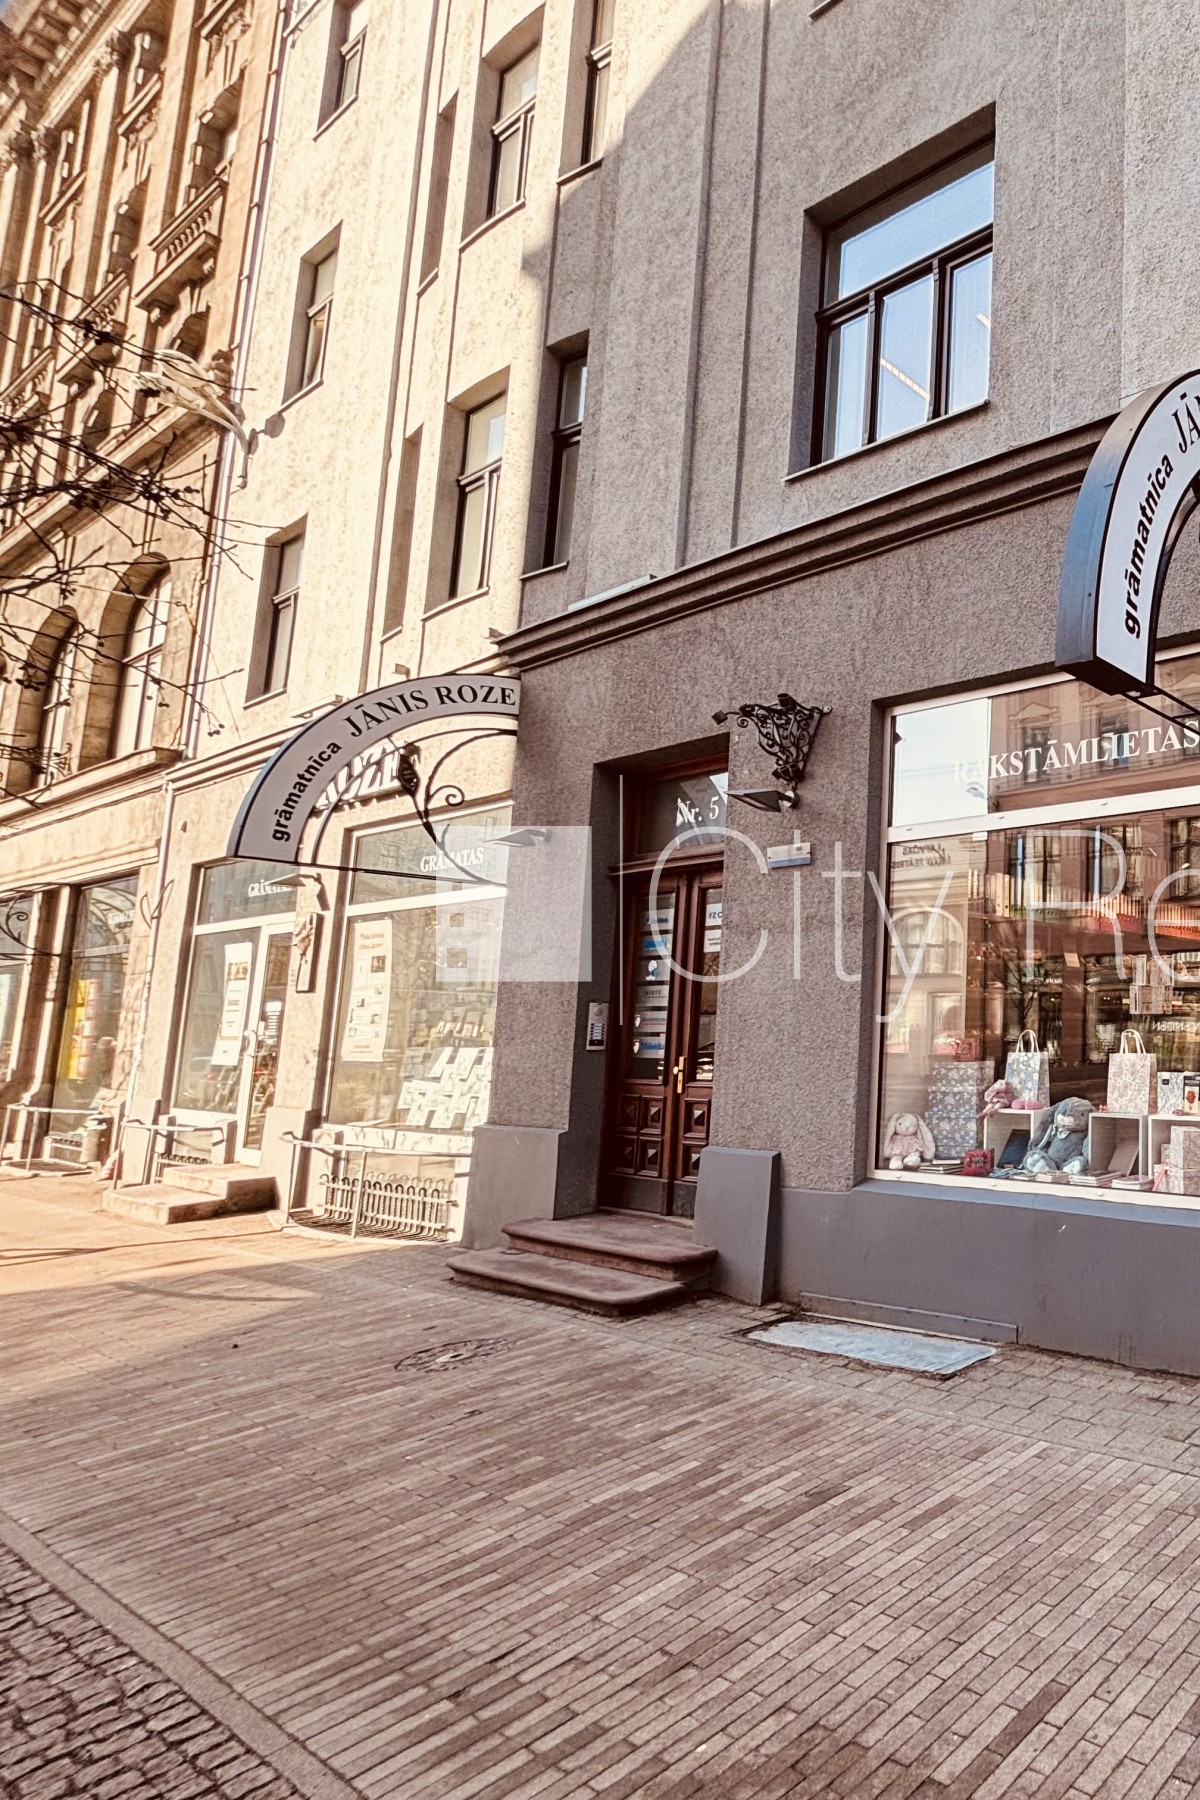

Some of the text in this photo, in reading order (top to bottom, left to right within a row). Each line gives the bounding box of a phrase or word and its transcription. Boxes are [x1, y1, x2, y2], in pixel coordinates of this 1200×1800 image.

[1124, 453, 1174, 640] grāmatnīca
[272, 684, 516, 843] grāmatnīca JĀNIS ROZE
[953, 719, 1200, 784] RAKSTĀMLIETAS
[677, 796, 719, 823] Nr. 5
[420, 847, 484, 872] GRĀMATAS
